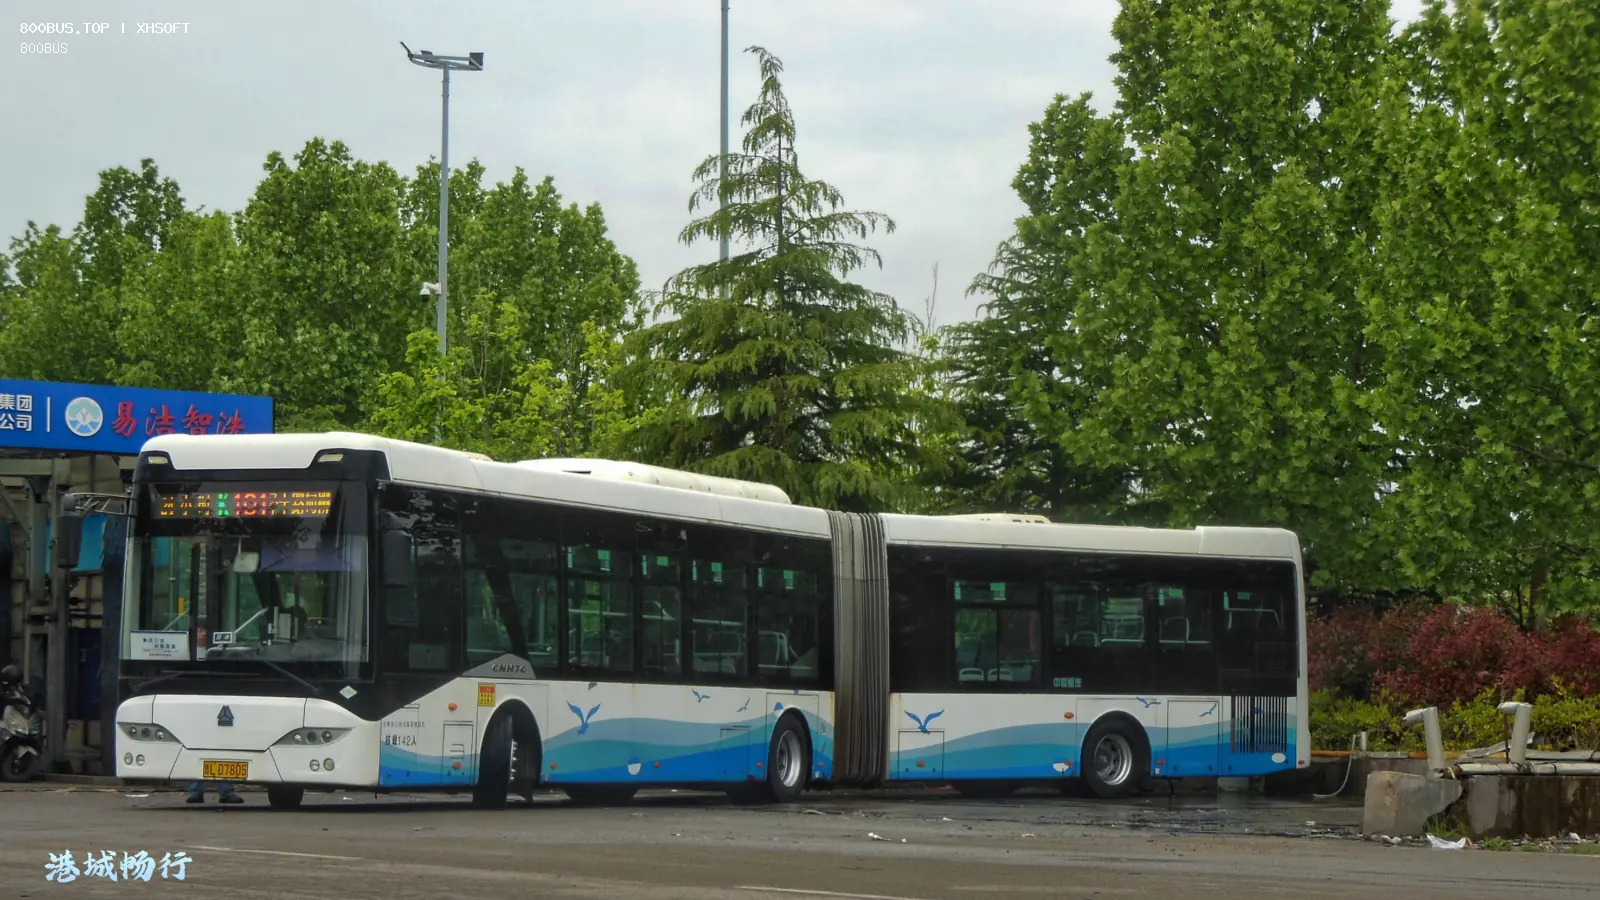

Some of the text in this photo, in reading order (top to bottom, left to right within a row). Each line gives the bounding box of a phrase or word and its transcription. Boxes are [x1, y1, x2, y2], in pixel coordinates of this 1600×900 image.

[0, 393, 33, 412] 集团
[0, 413, 33, 432] 公司
[491, 663, 527, 674] CNHTC
